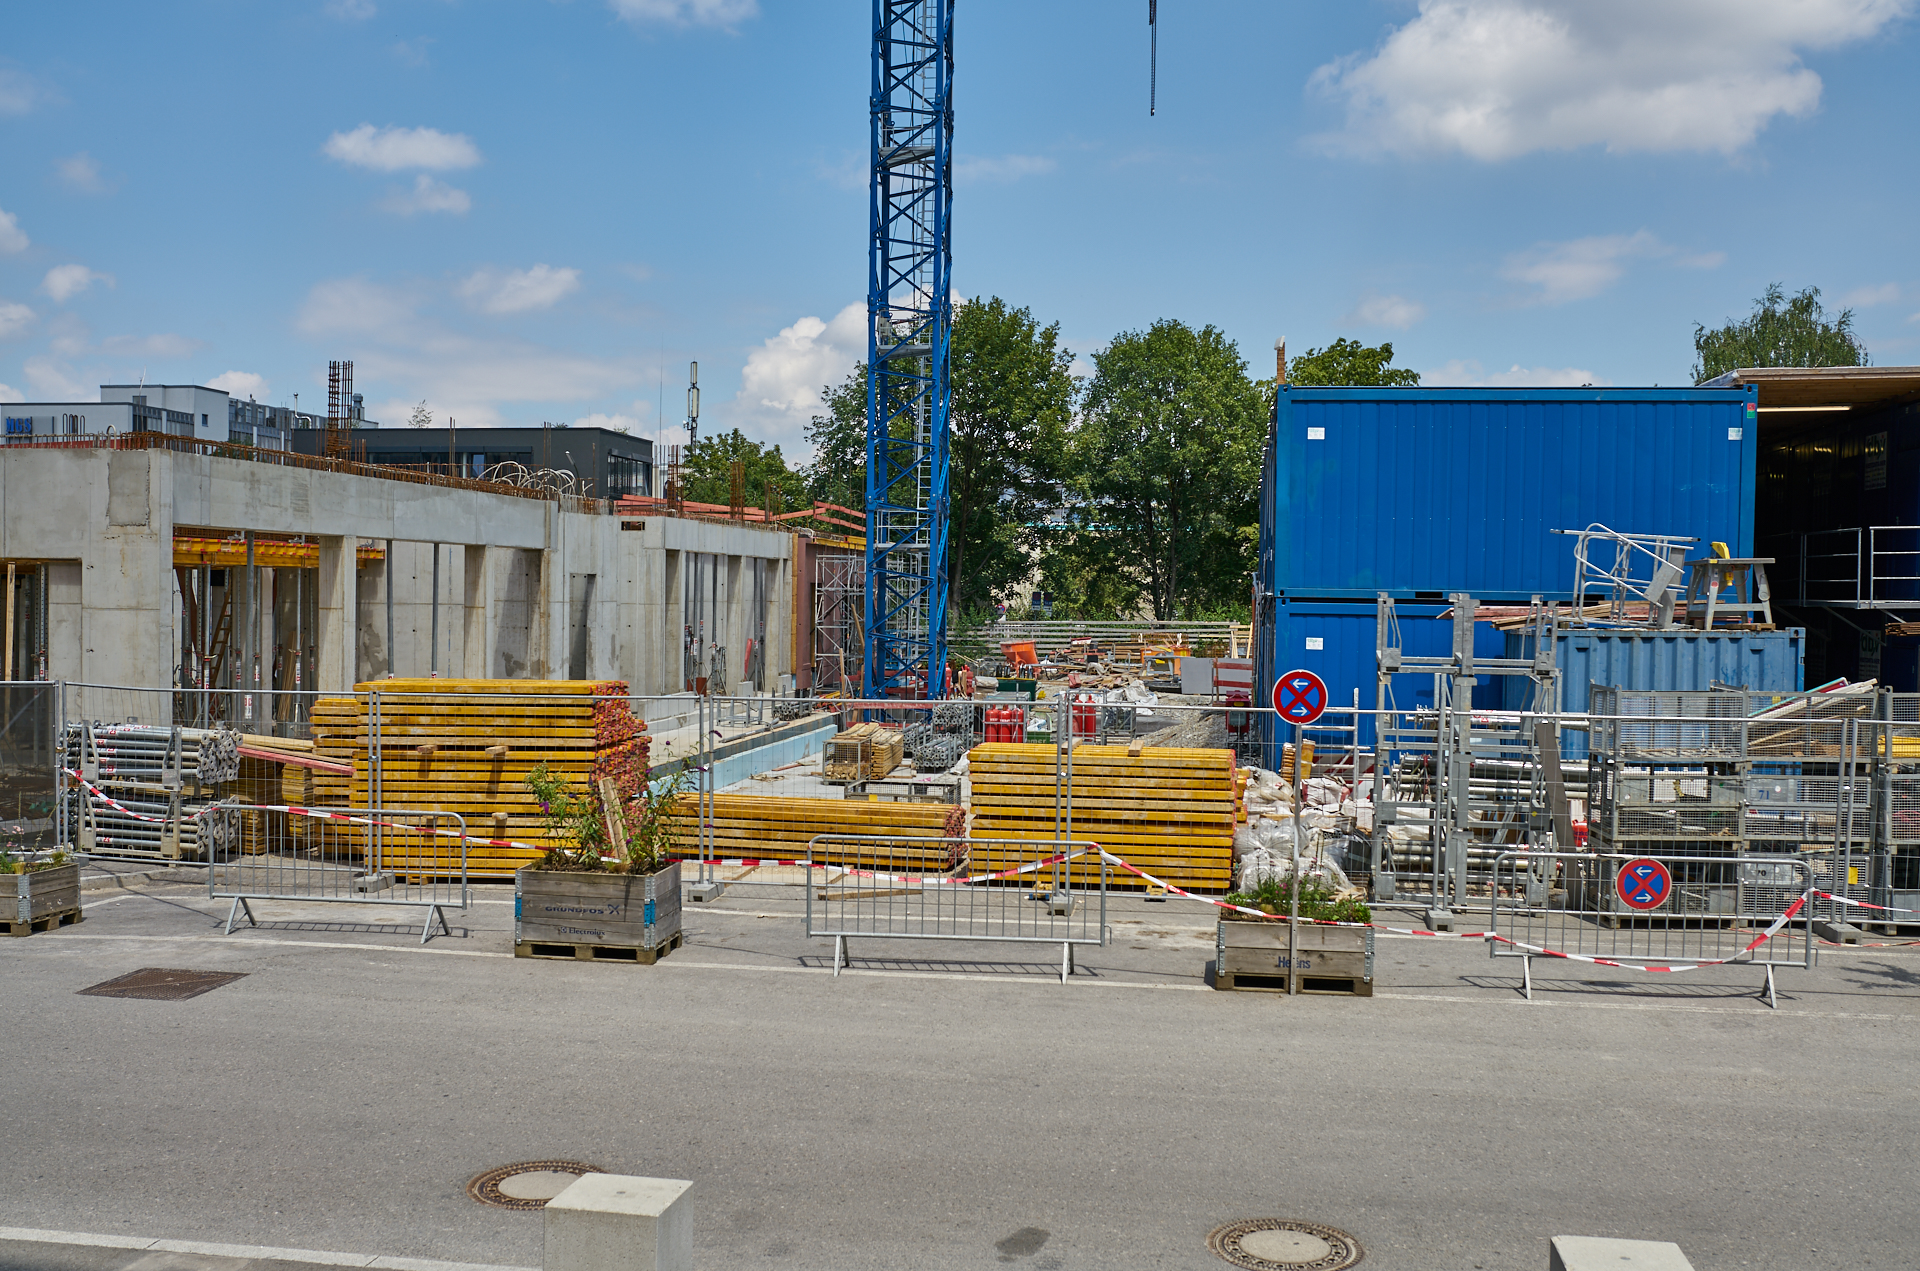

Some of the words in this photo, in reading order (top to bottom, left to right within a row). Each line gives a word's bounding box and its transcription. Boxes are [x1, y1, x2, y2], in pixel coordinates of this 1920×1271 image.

[1758, 789, 1770, 800] 71
[545, 906, 604, 915] GRUNDFOS
[569, 927, 606, 936] Electrolux
